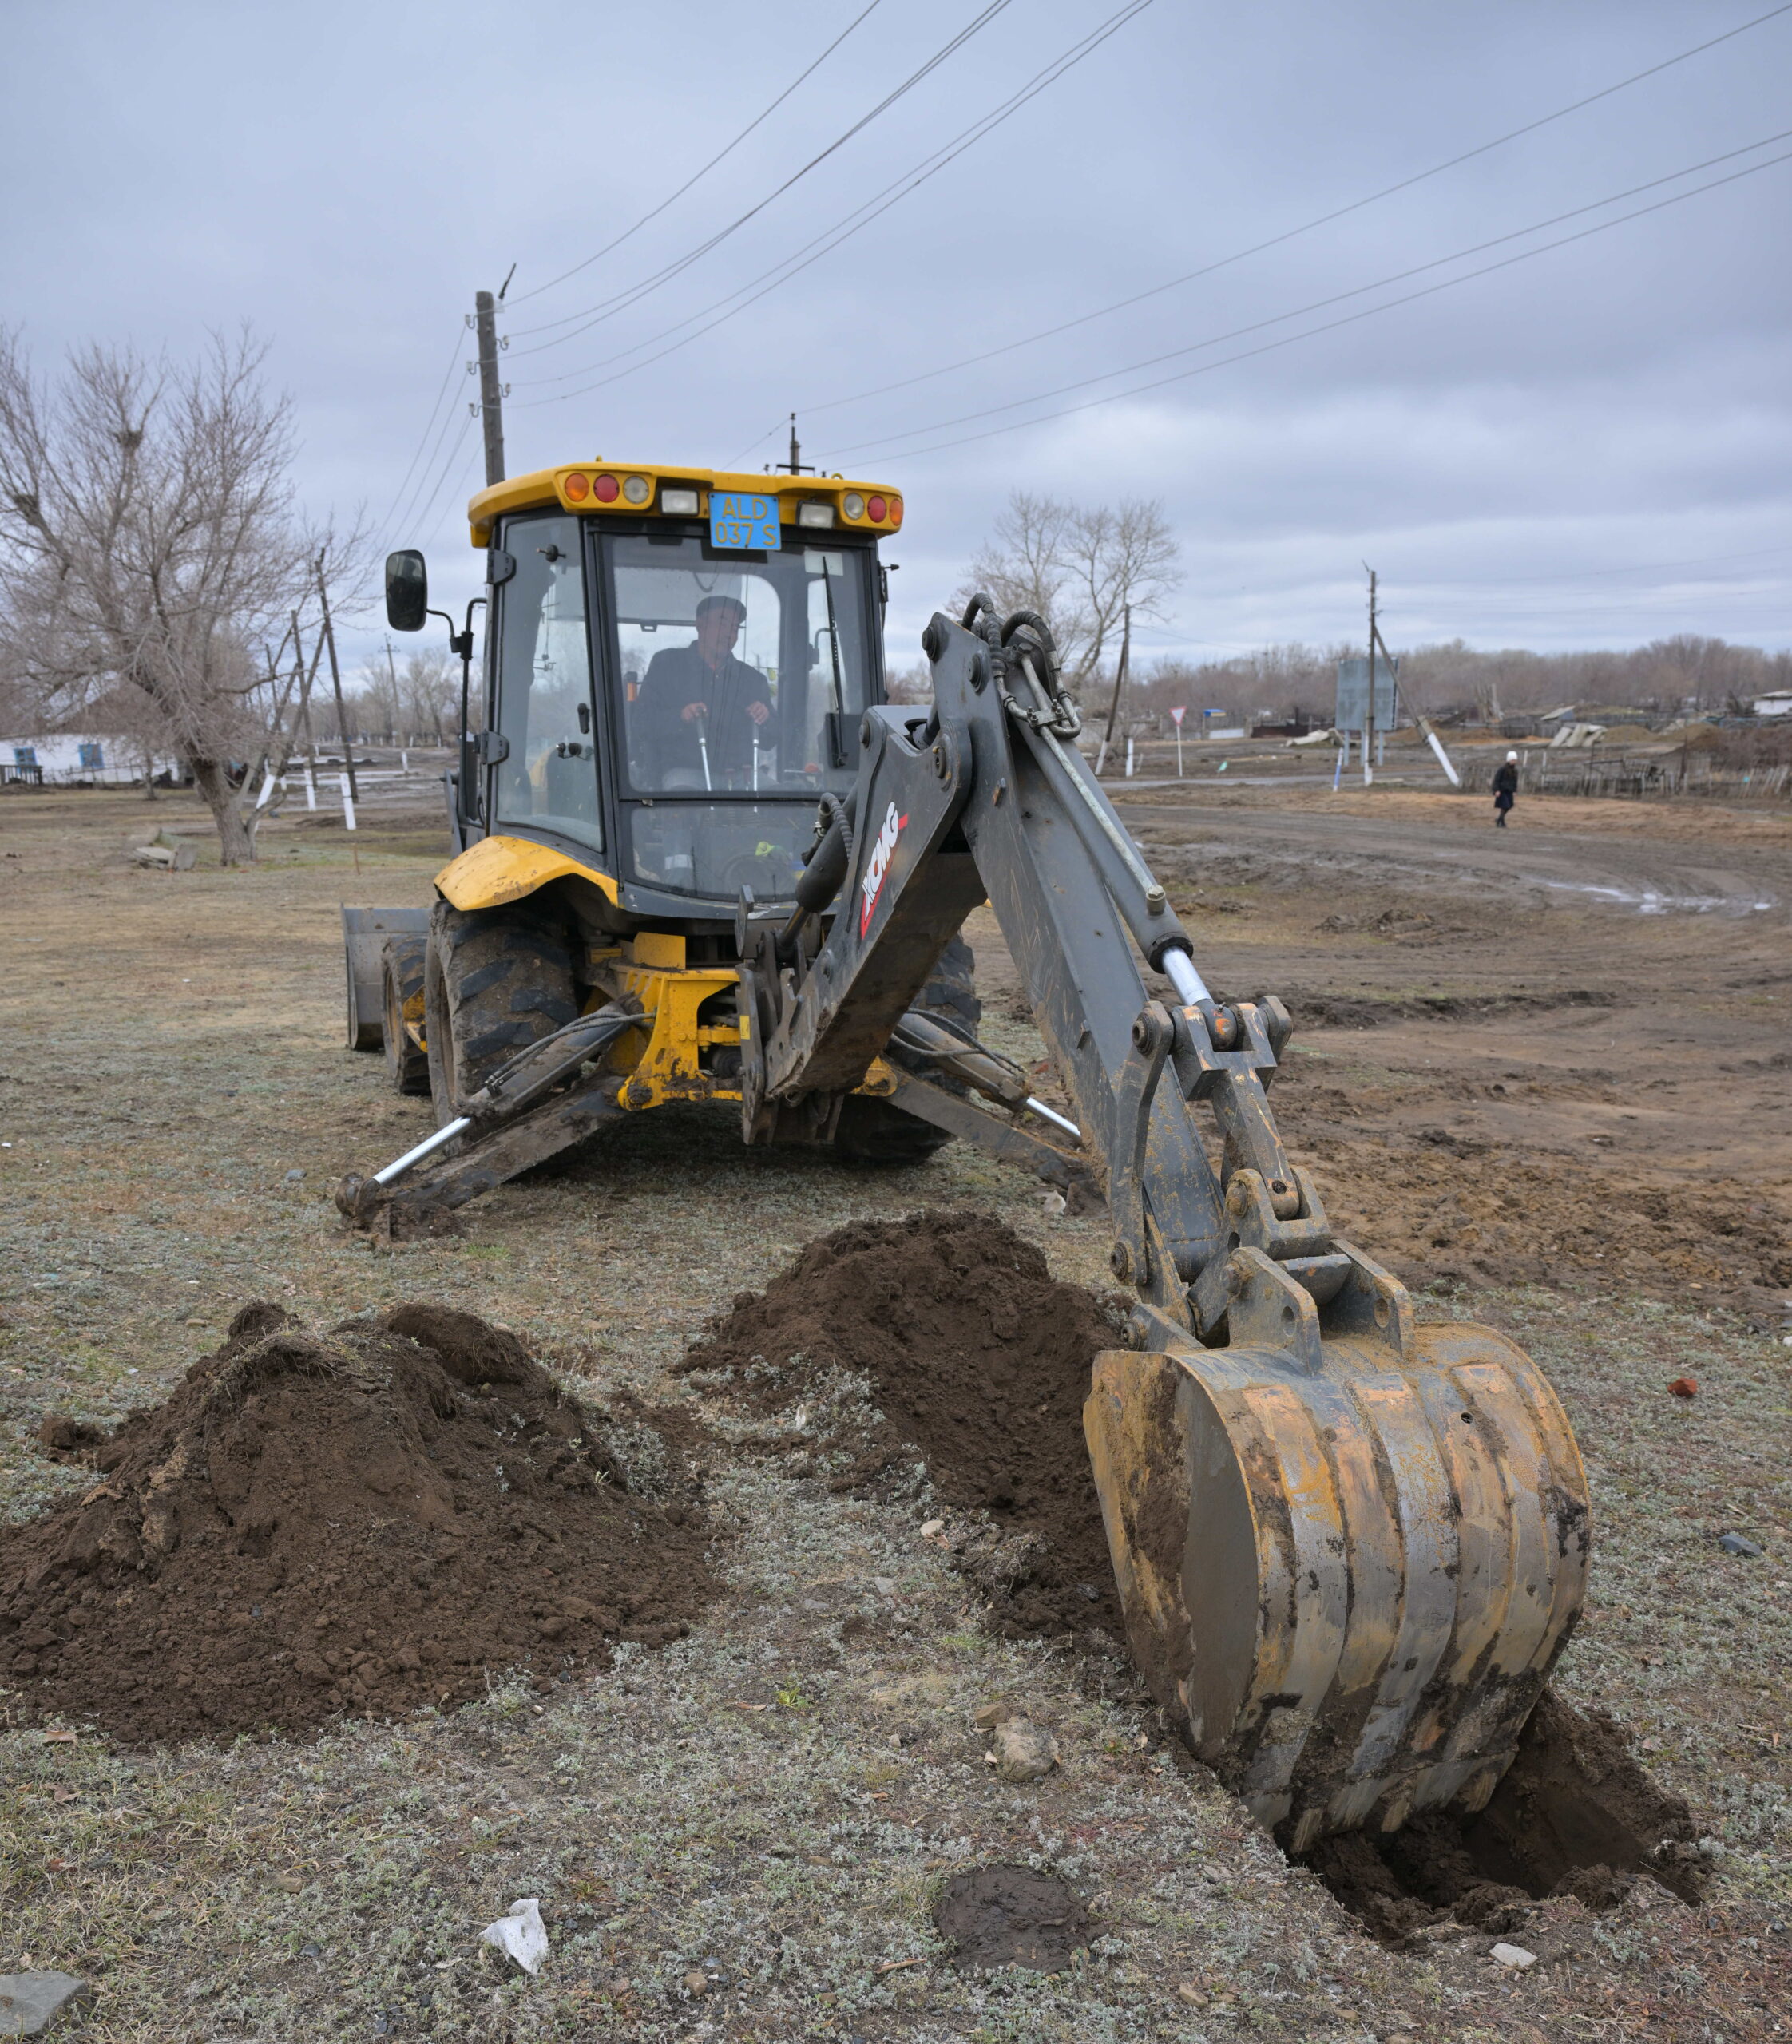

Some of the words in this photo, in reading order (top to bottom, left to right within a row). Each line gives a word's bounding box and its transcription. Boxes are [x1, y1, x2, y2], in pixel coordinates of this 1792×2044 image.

[722, 497, 767, 520] ALD
[715, 521, 754, 545] 037
[763, 524, 776, 545] S
[862, 801, 899, 921] XCMG
